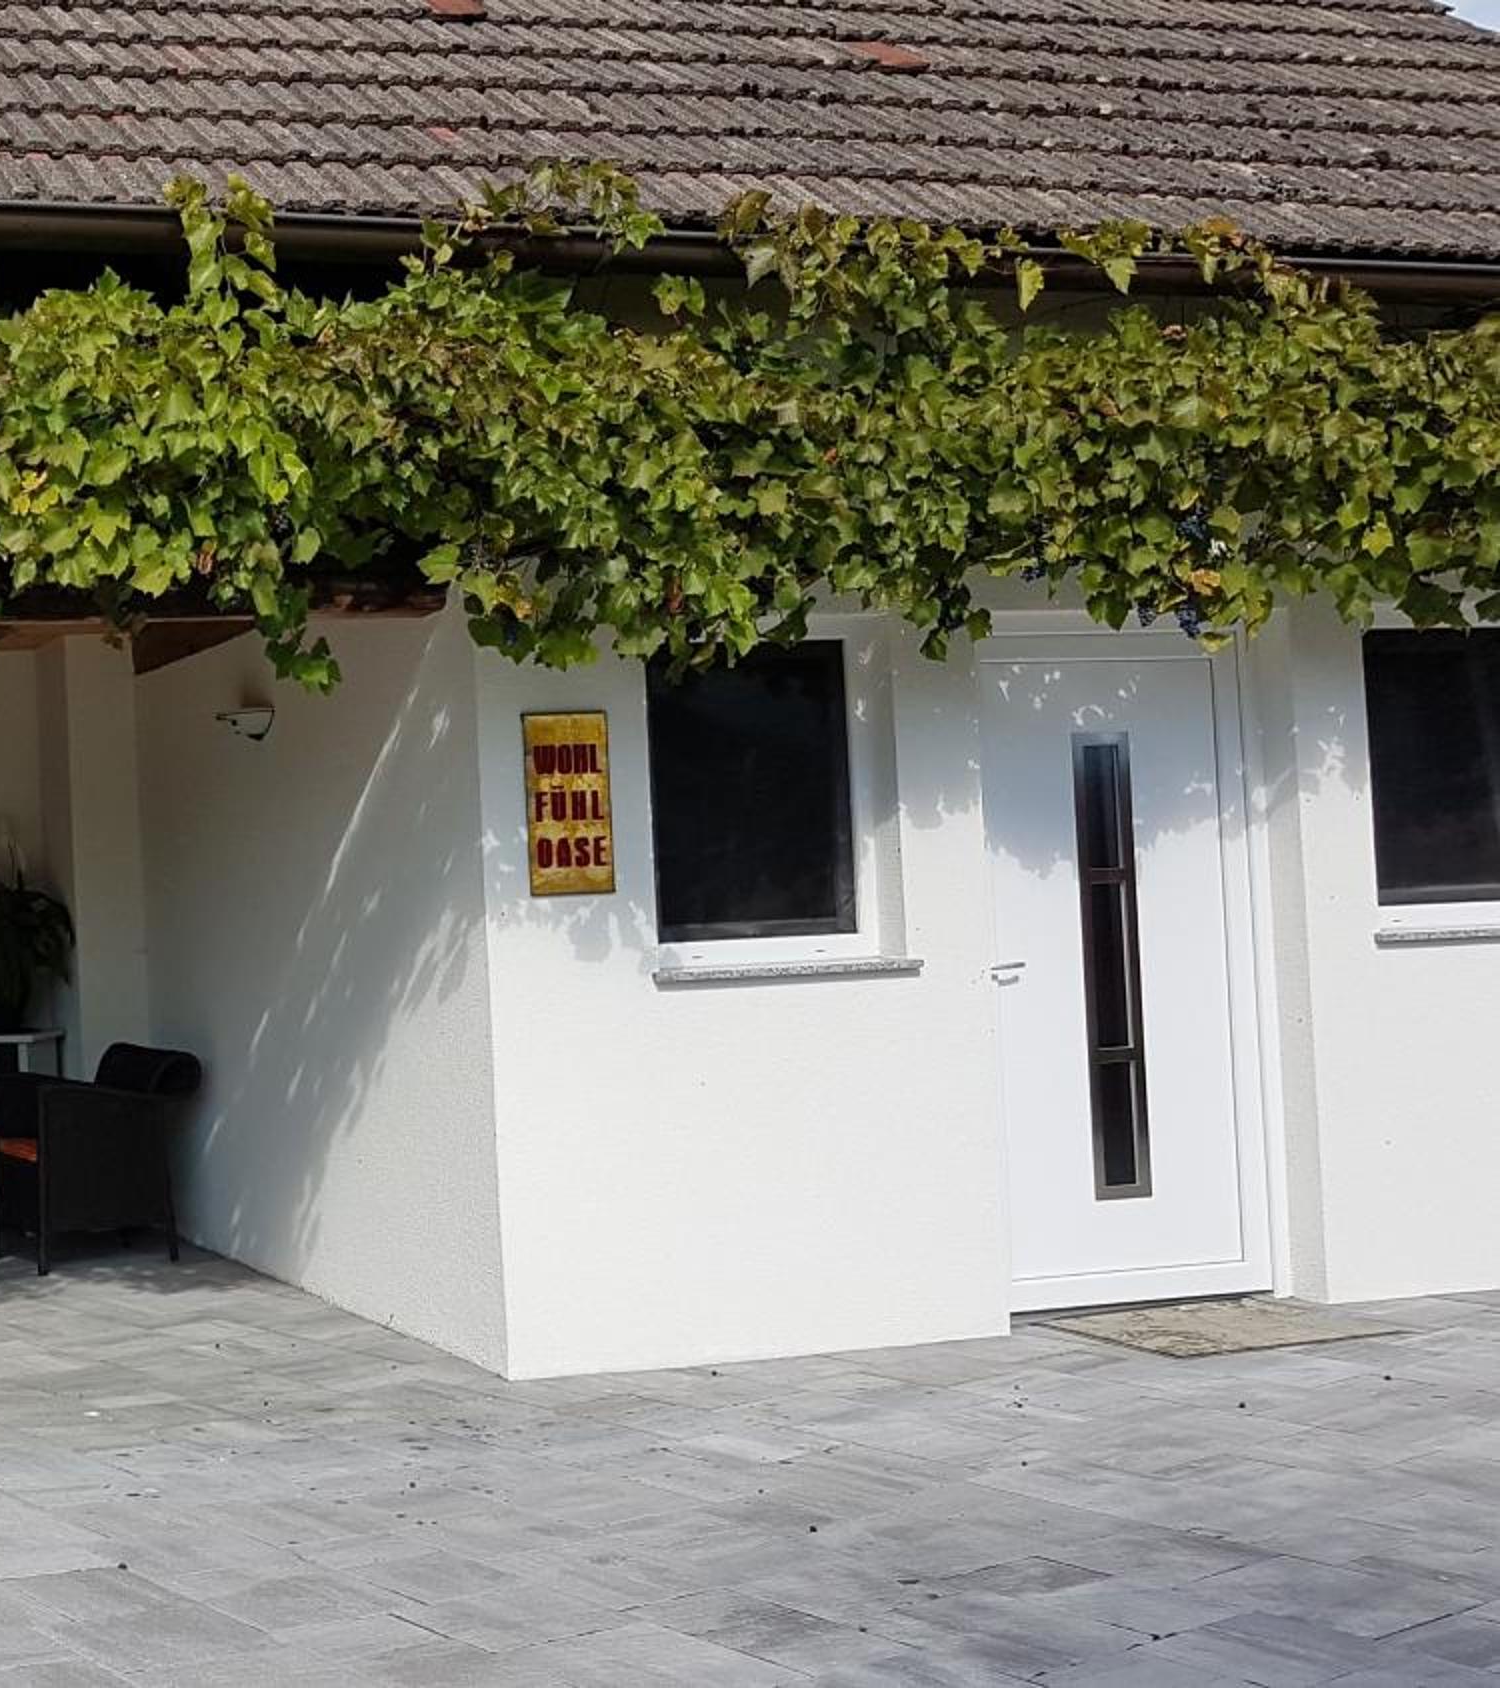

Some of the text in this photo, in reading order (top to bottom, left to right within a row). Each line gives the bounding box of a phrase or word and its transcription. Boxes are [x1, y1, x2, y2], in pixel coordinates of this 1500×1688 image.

[533, 744, 602, 774] WOHL
[534, 785, 604, 822] FÜHL
[537, 836, 609, 868] OASE
